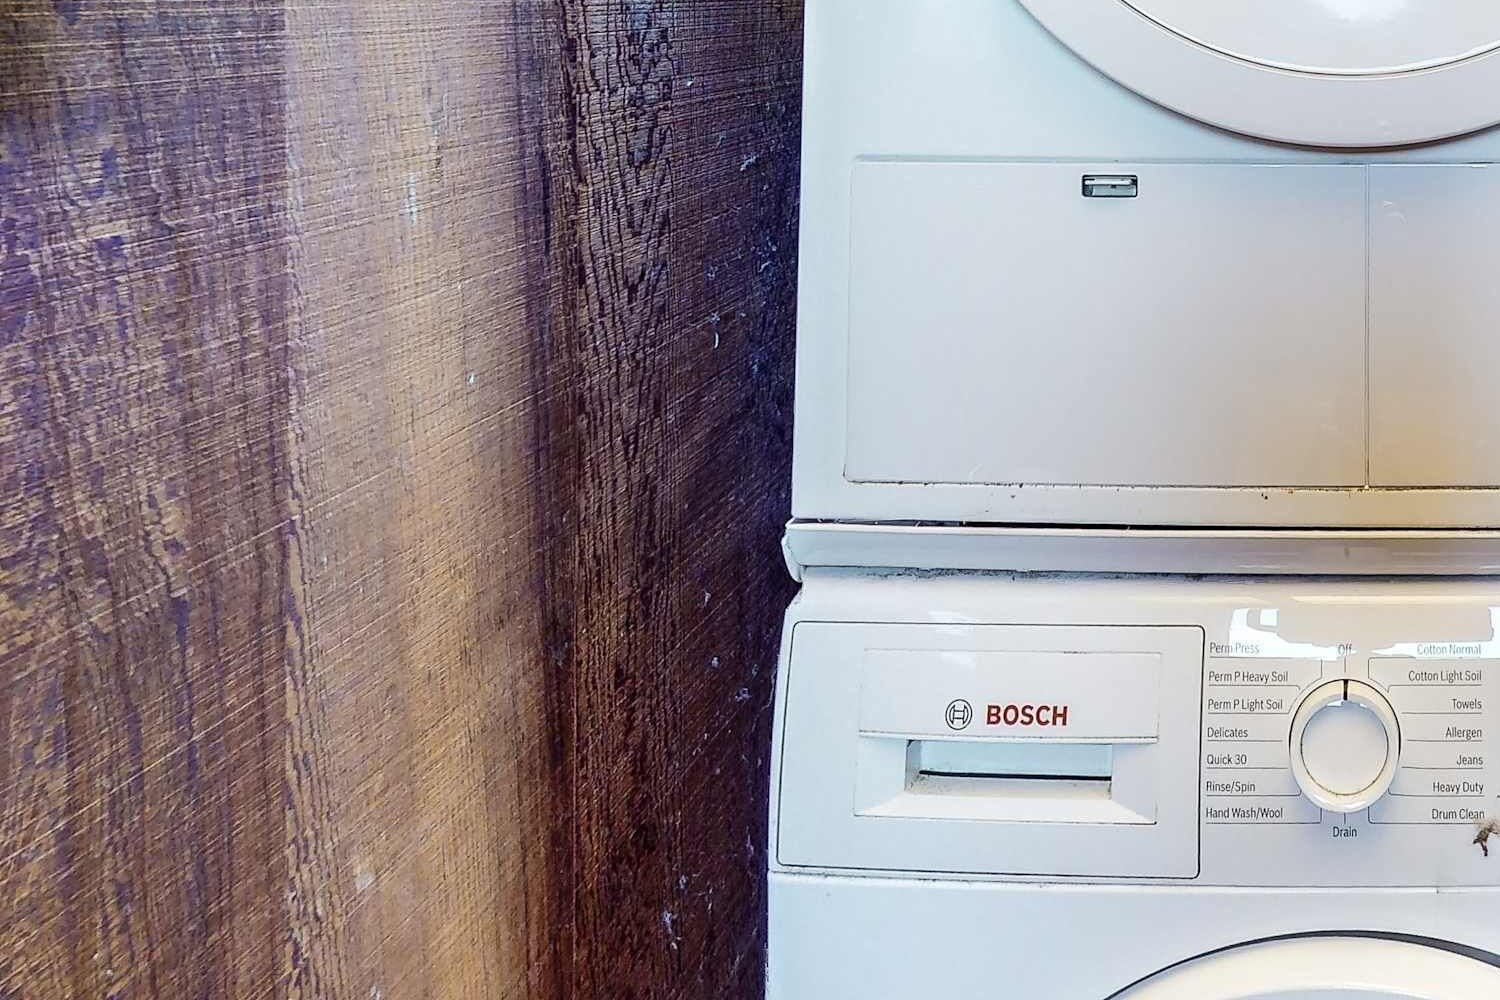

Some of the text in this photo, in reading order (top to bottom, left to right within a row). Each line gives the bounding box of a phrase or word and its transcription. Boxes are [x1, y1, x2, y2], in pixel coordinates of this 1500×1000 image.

[1209, 642, 1260, 654] Perm Press
[1337, 643, 1353, 656] Off
[1417, 643, 1482, 655] Cotton Normal
[1208, 670, 1289, 684] Perm P Heavy Soil
[1408, 669, 1482, 684] Cotton Light Soil
[1207, 698, 1283, 712] Perm P Light Soil
[1452, 698, 1483, 710] Towels
[986, 704, 1068, 726] BOSCH
[1206, 726, 1249, 739] Delicates
[1445, 726, 1483, 741] Allergen
[1206, 753, 1248, 765] Quick 30
[1456, 754, 1484, 766] Jeans
[1205, 780, 1256, 794] Rinse/Spin
[1432, 781, 1484, 794] Heavy Duty
[1205, 807, 1284, 819] Hand Wash/Wool
[1431, 808, 1485, 820] Drum Clean
[1332, 825, 1358, 838] Drain
